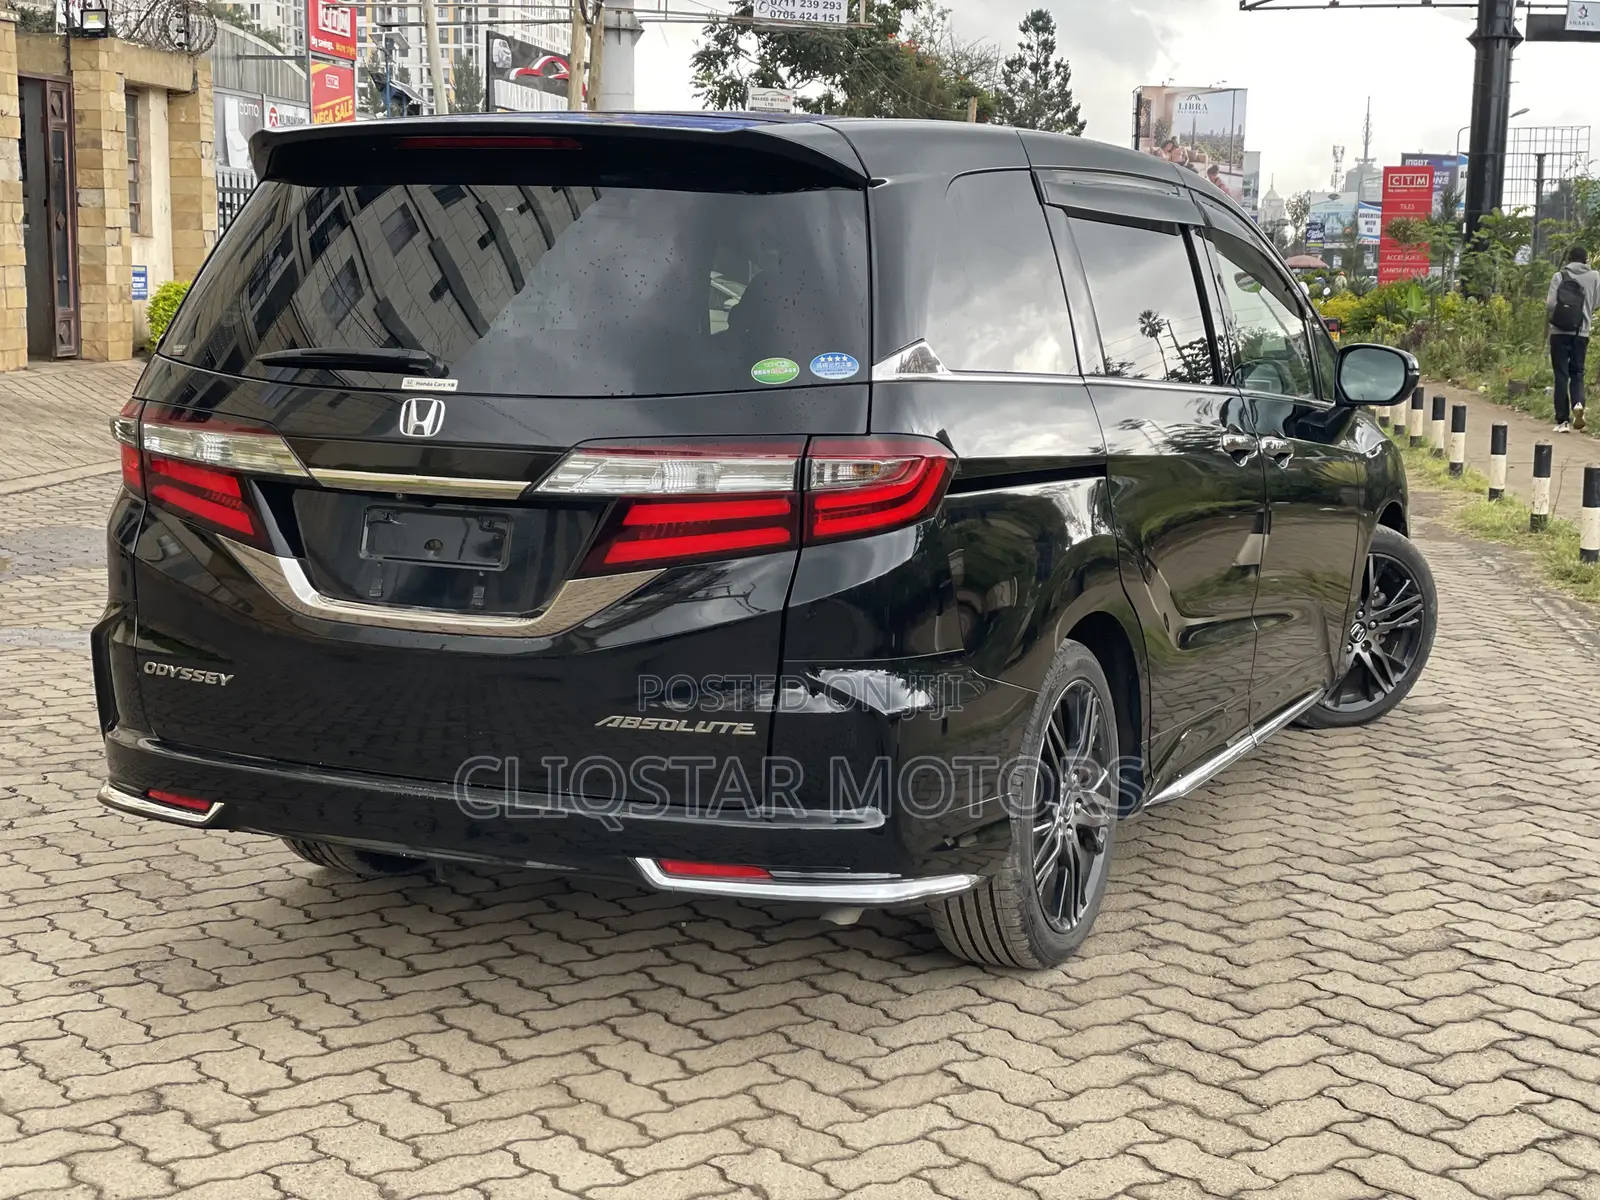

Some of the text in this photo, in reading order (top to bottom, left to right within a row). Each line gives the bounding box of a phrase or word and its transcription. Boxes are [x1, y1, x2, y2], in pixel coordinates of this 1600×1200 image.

[800, 0, 820, 9] 239
[822, 1, 842, 10] 293
[769, 10, 840, 22] 0705 424 151
[313, 99, 353, 124] MEGA SALE
[1178, 102, 1208, 110] LIBRA
[1391, 175, 1427, 186] CTM
[143, 661, 235, 686] ODYSSEY
[594, 715, 757, 736] ABSOLUTE
